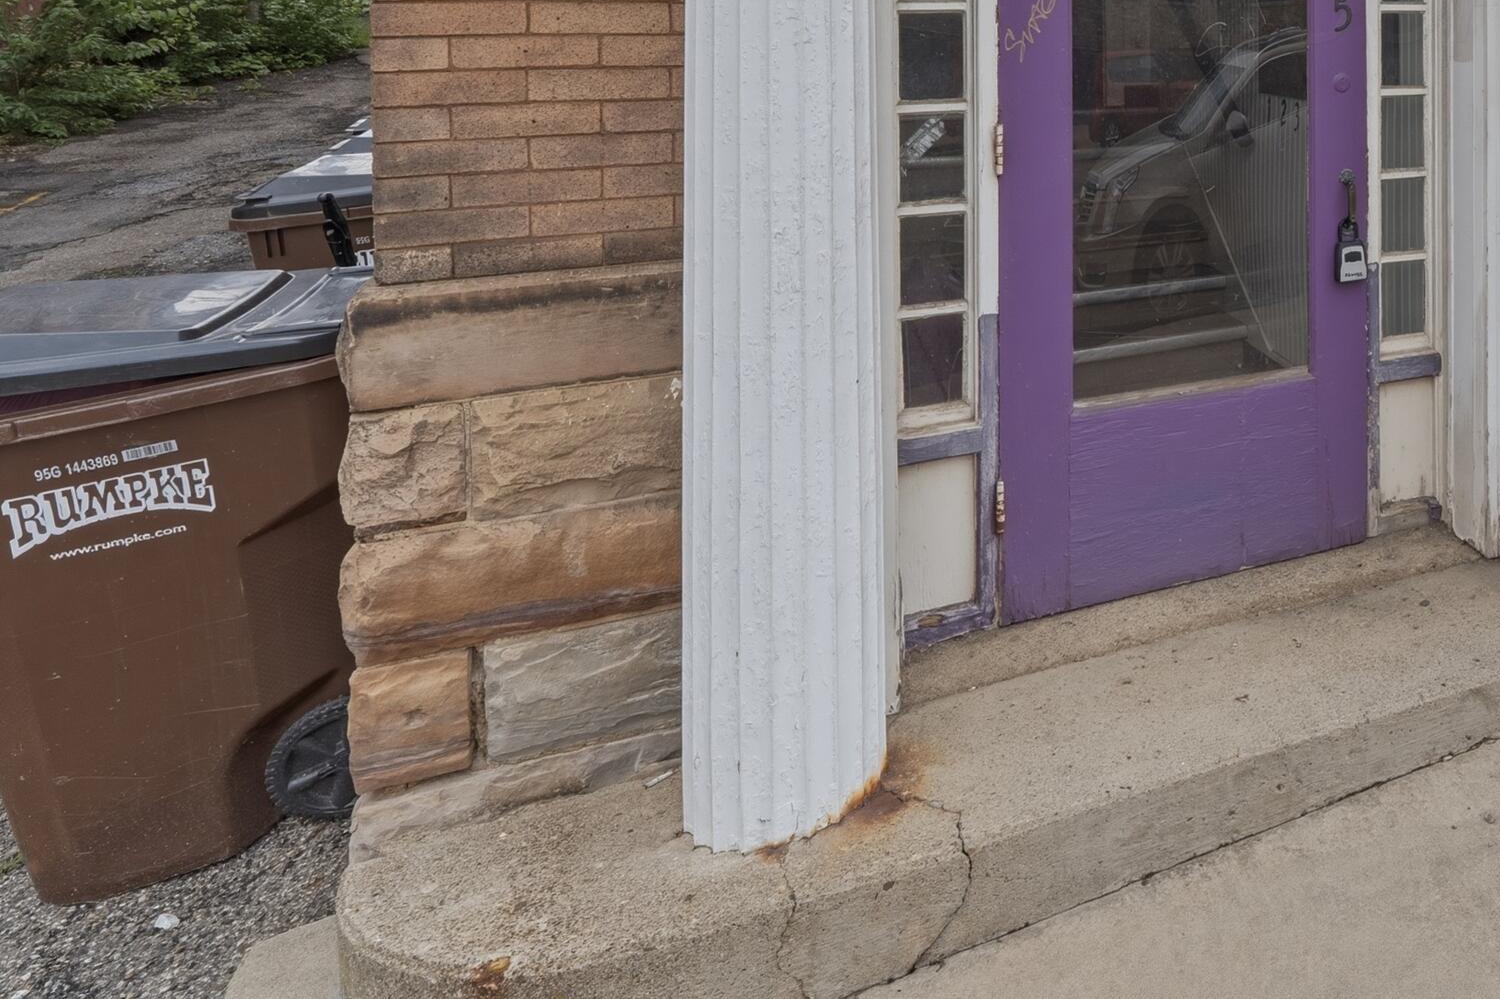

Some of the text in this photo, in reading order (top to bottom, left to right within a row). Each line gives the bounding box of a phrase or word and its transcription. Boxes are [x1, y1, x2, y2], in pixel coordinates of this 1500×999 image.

[34, 466, 62, 482] 95G
[2, 458, 216, 559] RUMPKE
[50, 523, 187, 561] www.rumpke.com
